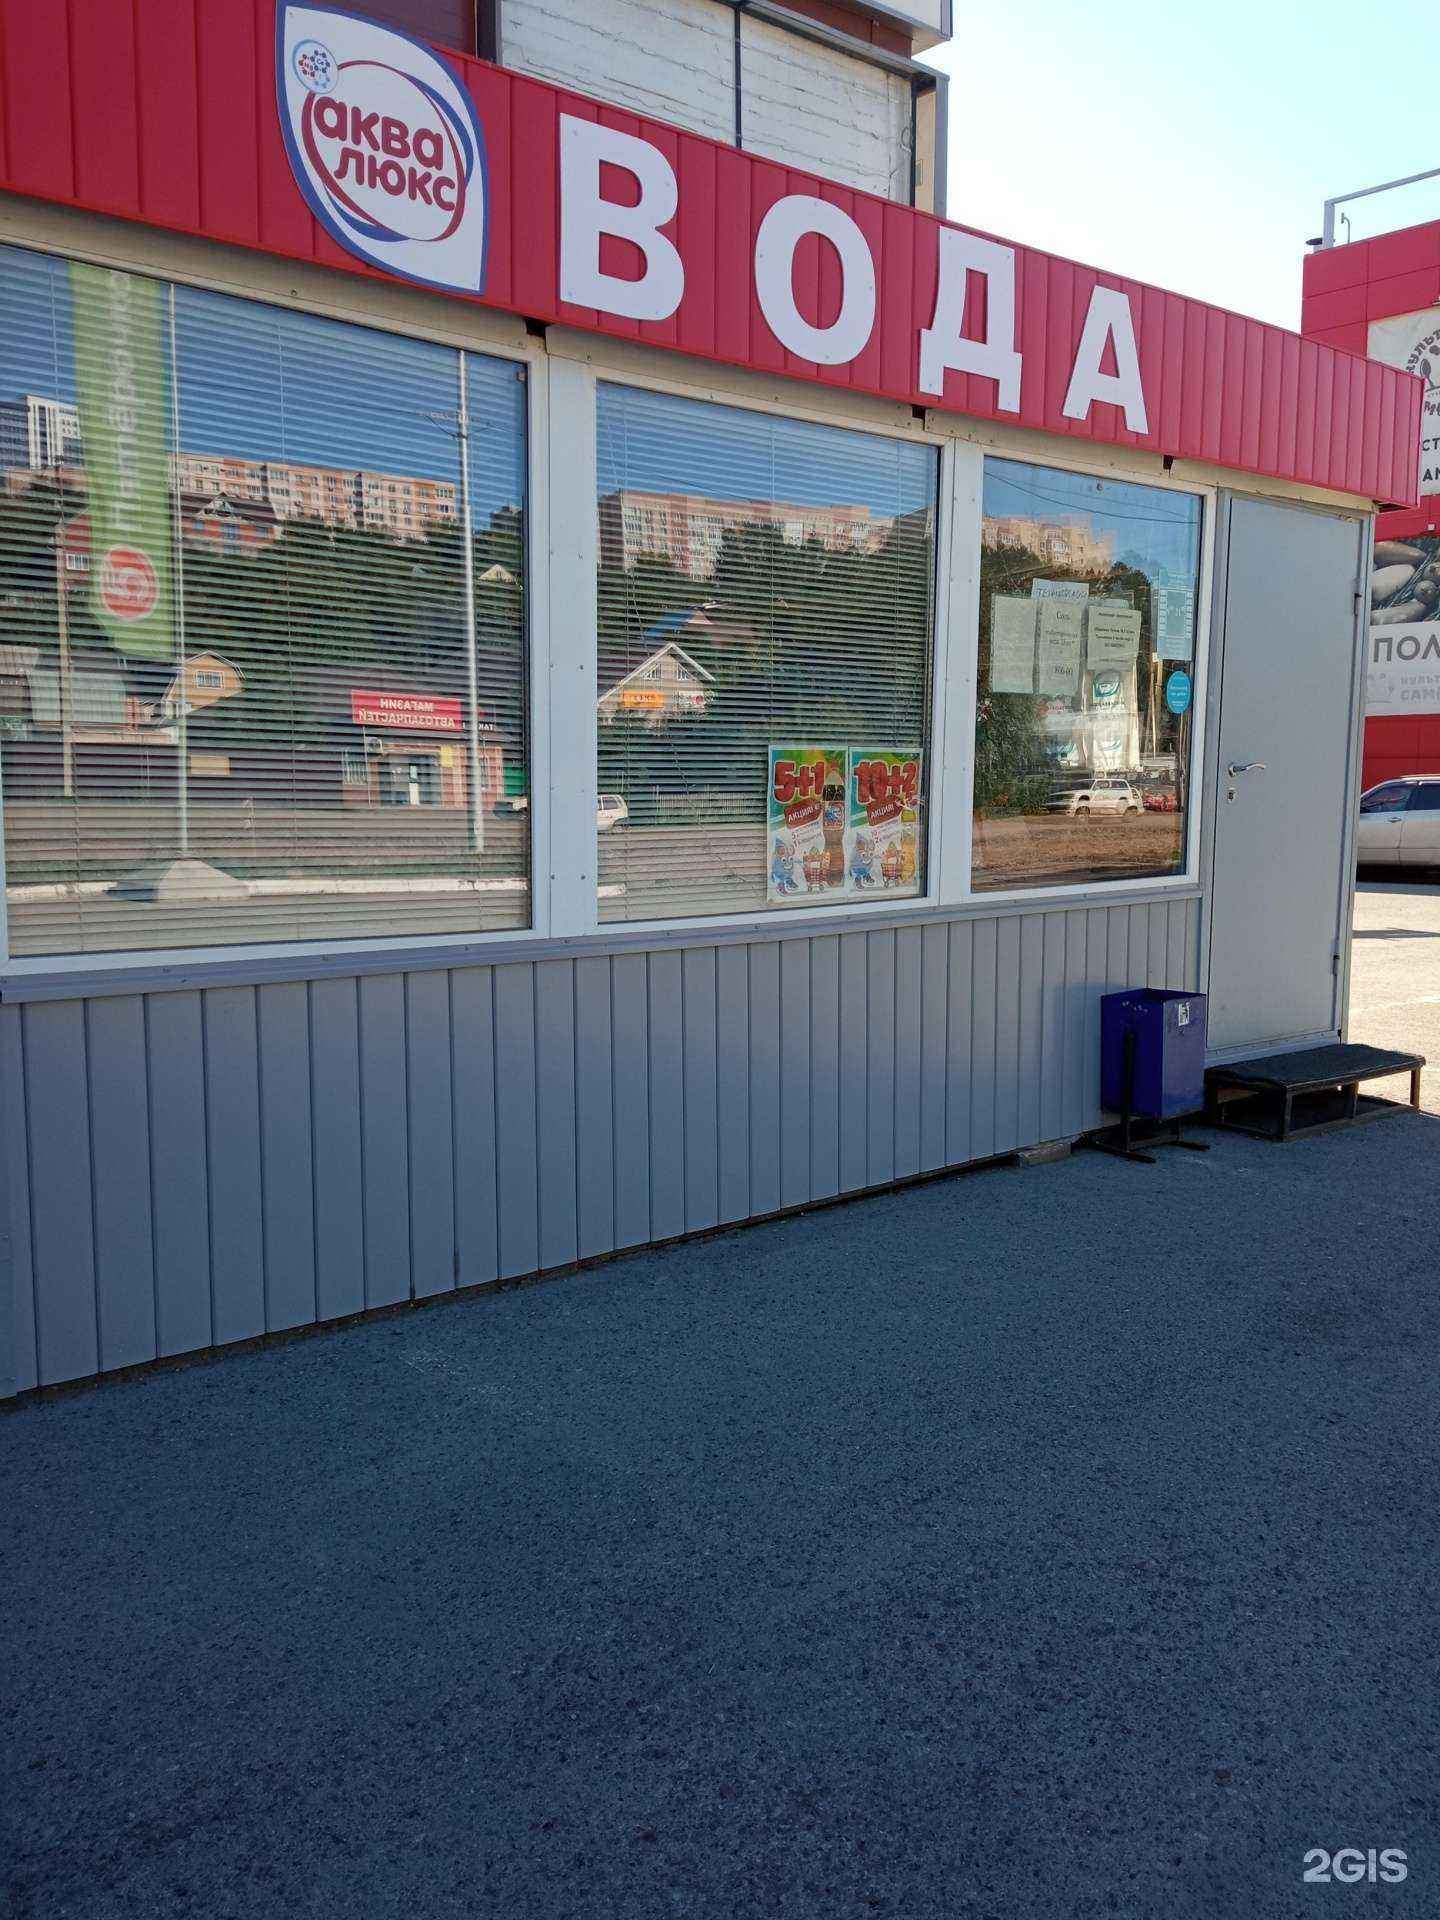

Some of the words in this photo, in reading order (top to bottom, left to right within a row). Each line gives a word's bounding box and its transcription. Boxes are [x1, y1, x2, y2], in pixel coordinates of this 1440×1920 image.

[560, 112, 1148, 435] ВОДА
[773, 760, 826, 803] 5+1
[855, 760, 918, 804] 10+2
